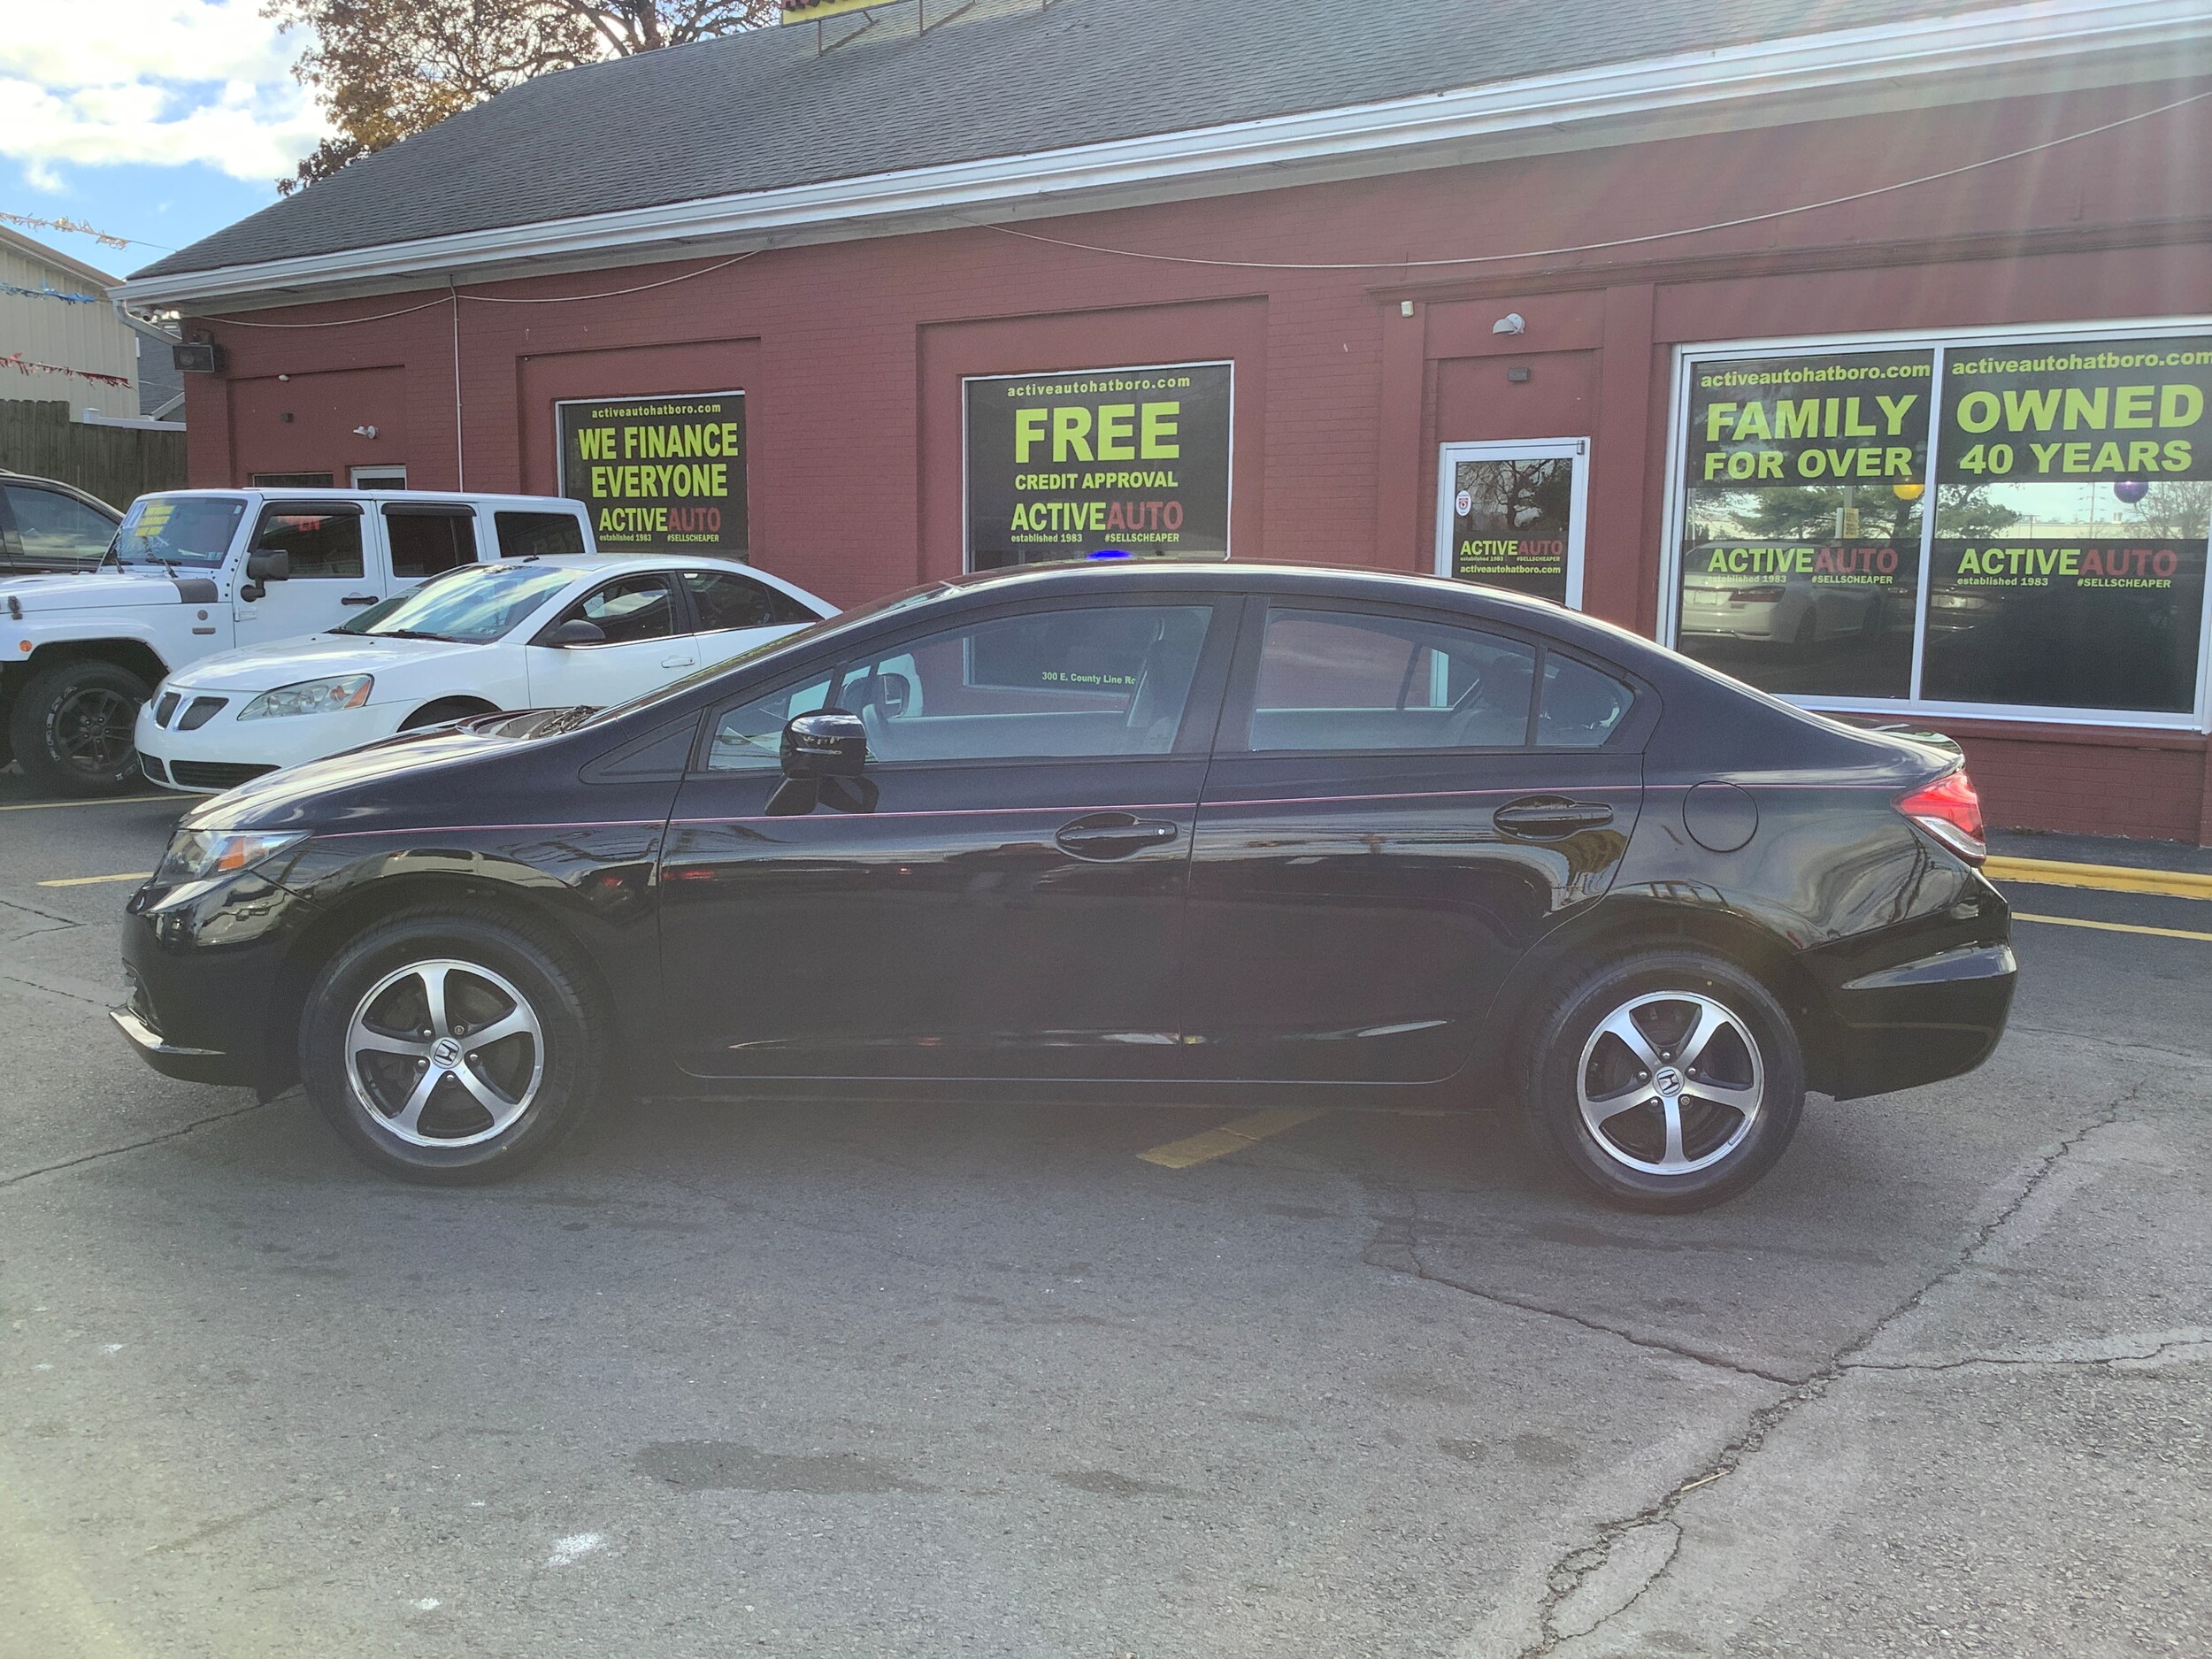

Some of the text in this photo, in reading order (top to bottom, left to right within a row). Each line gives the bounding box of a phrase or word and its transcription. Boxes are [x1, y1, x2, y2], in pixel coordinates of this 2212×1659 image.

[1952, 351, 2212, 375] activeautohatboro.com
[1701, 363, 1931, 388] activeautohatboro.com
[1007, 375, 1191, 397] activeautohatboro.com
[592, 403, 721, 419] activeautohatboro.com
[1706, 383, 2204, 442] FAMILY OWNED
[578, 422, 739, 460] WE FINANCE
[1015, 401, 1180, 464] FREE
[1704, 440, 2193, 480] FOR OVER 40 YEARS
[591, 463, 728, 498] EVERYONE
[1015, 471, 1179, 490] CREDIT APPROVAL
[667, 534, 719, 542] #SELLSCHEAPER
[1011, 533, 1179, 542] established 1983 #SELLSCHEAPER
[1460, 565, 1561, 574] activeautohatboro.com
[1811, 575, 1893, 585] #SELLSCHEAPER
[1957, 577, 2171, 588] established 1983 #SELLSCHEAPER
[1042, 672, 1058, 680] 300
[1071, 673, 1101, 684] County
[1103, 675, 1122, 684] Line
